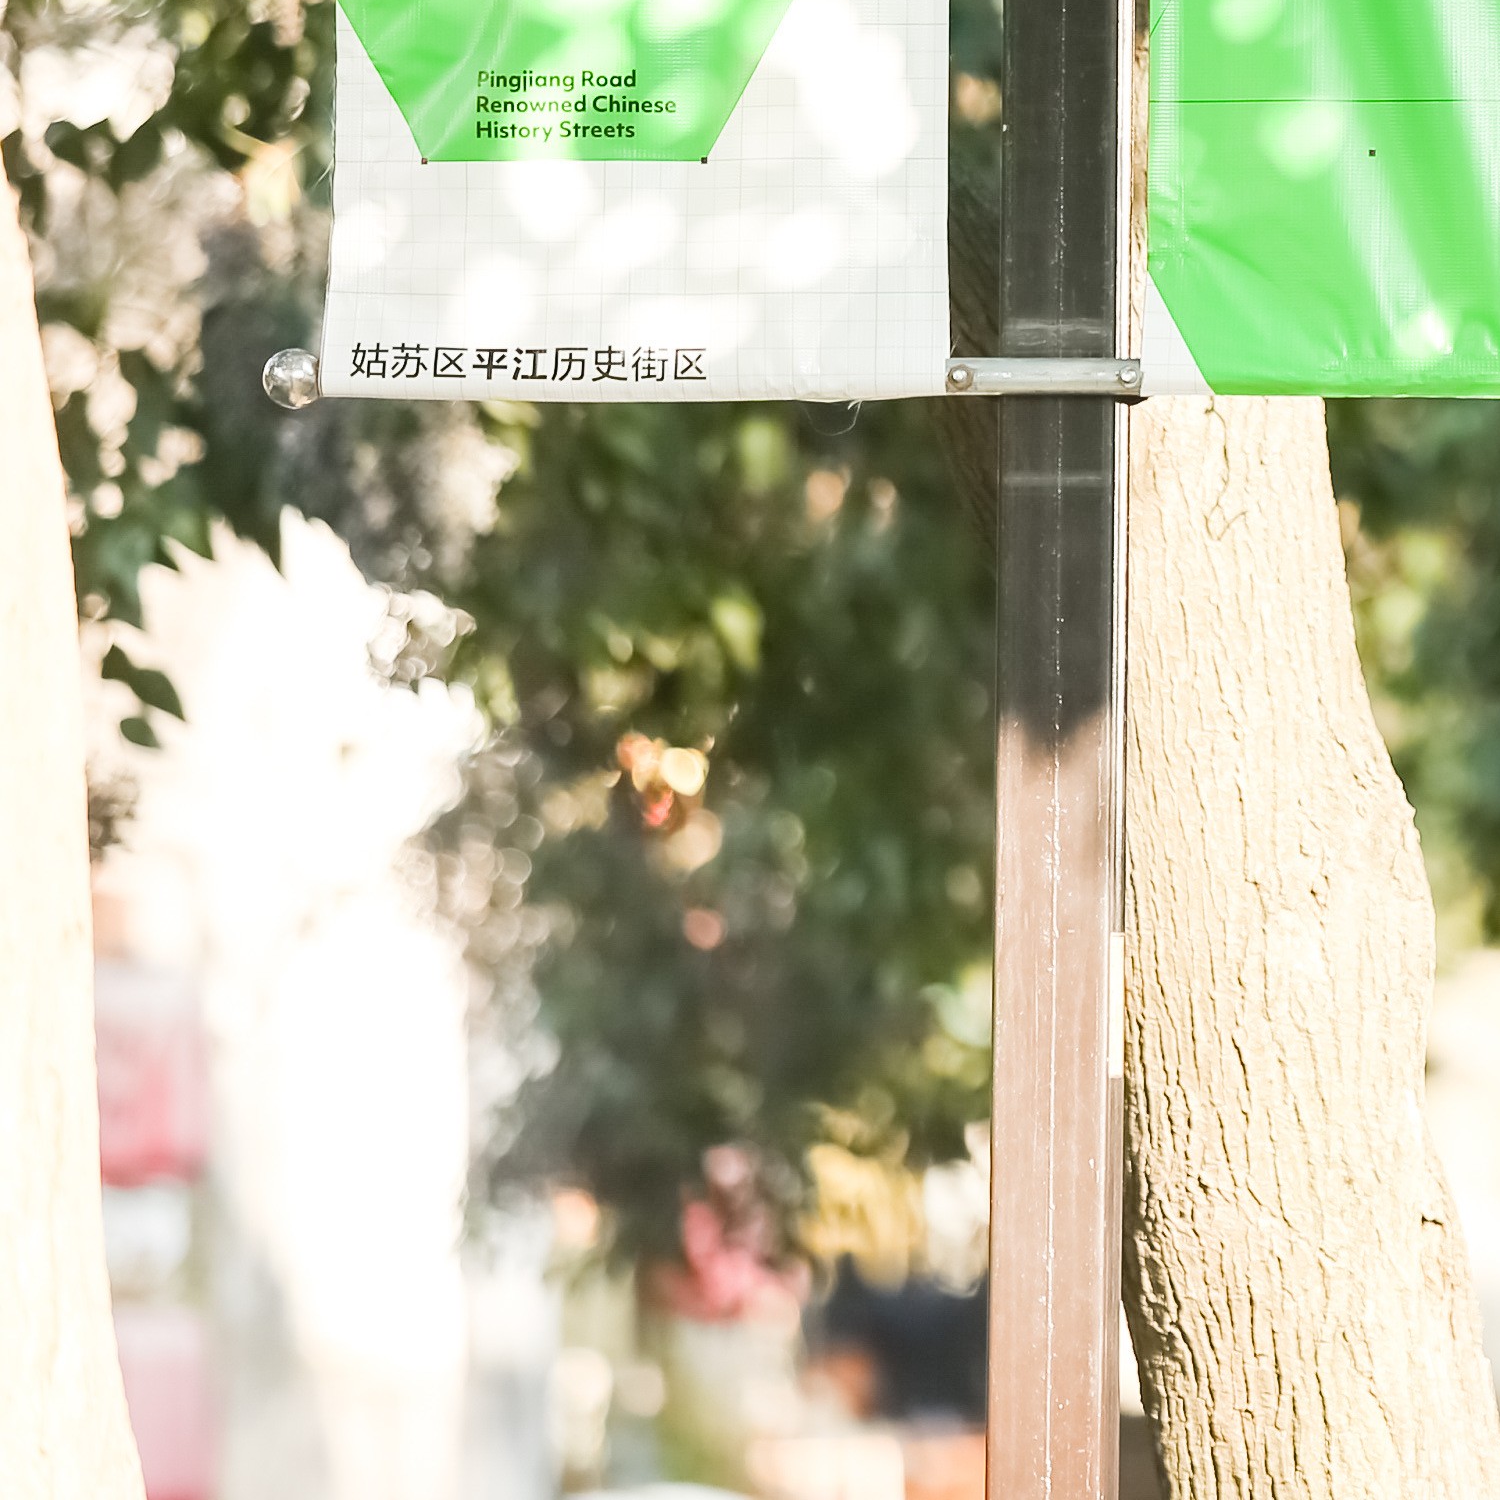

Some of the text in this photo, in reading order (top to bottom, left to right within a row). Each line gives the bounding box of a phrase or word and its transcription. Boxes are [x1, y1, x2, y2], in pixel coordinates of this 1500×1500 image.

[477, 69, 636, 92] Pingjiang Road
[476, 95, 676, 113] Renowned Chinese
[476, 120, 635, 142] History Streets
[350, 342, 707, 382] 姑苏区平江历史街区
